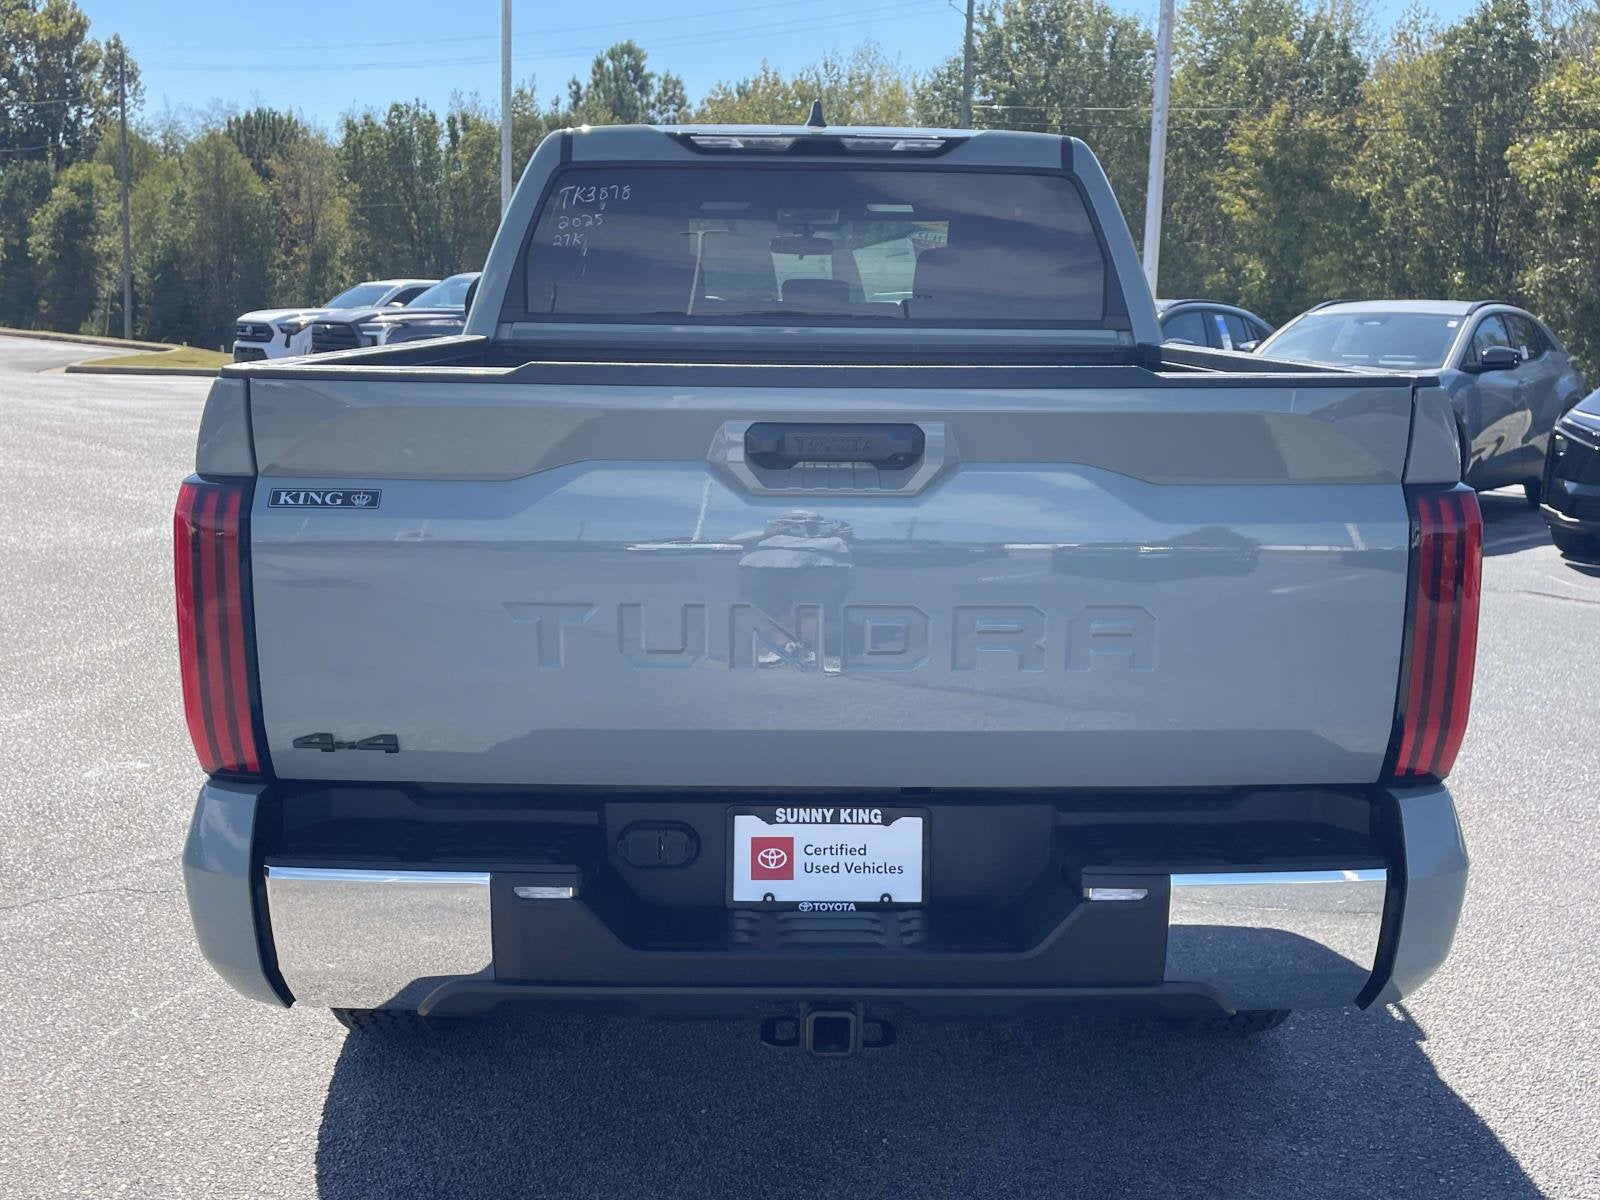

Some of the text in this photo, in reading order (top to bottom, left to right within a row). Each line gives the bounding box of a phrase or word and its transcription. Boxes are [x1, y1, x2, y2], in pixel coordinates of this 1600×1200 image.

[557, 214, 604, 230] 2025
[278, 491, 344, 506] KING
[503, 602, 1160, 673] TUNDRA
[775, 807, 882, 825] SUNNY KING
[803, 843, 867, 856] Certified
[803, 861, 904, 875] Used Vehicles
[813, 901, 856, 913] TOYOTA
